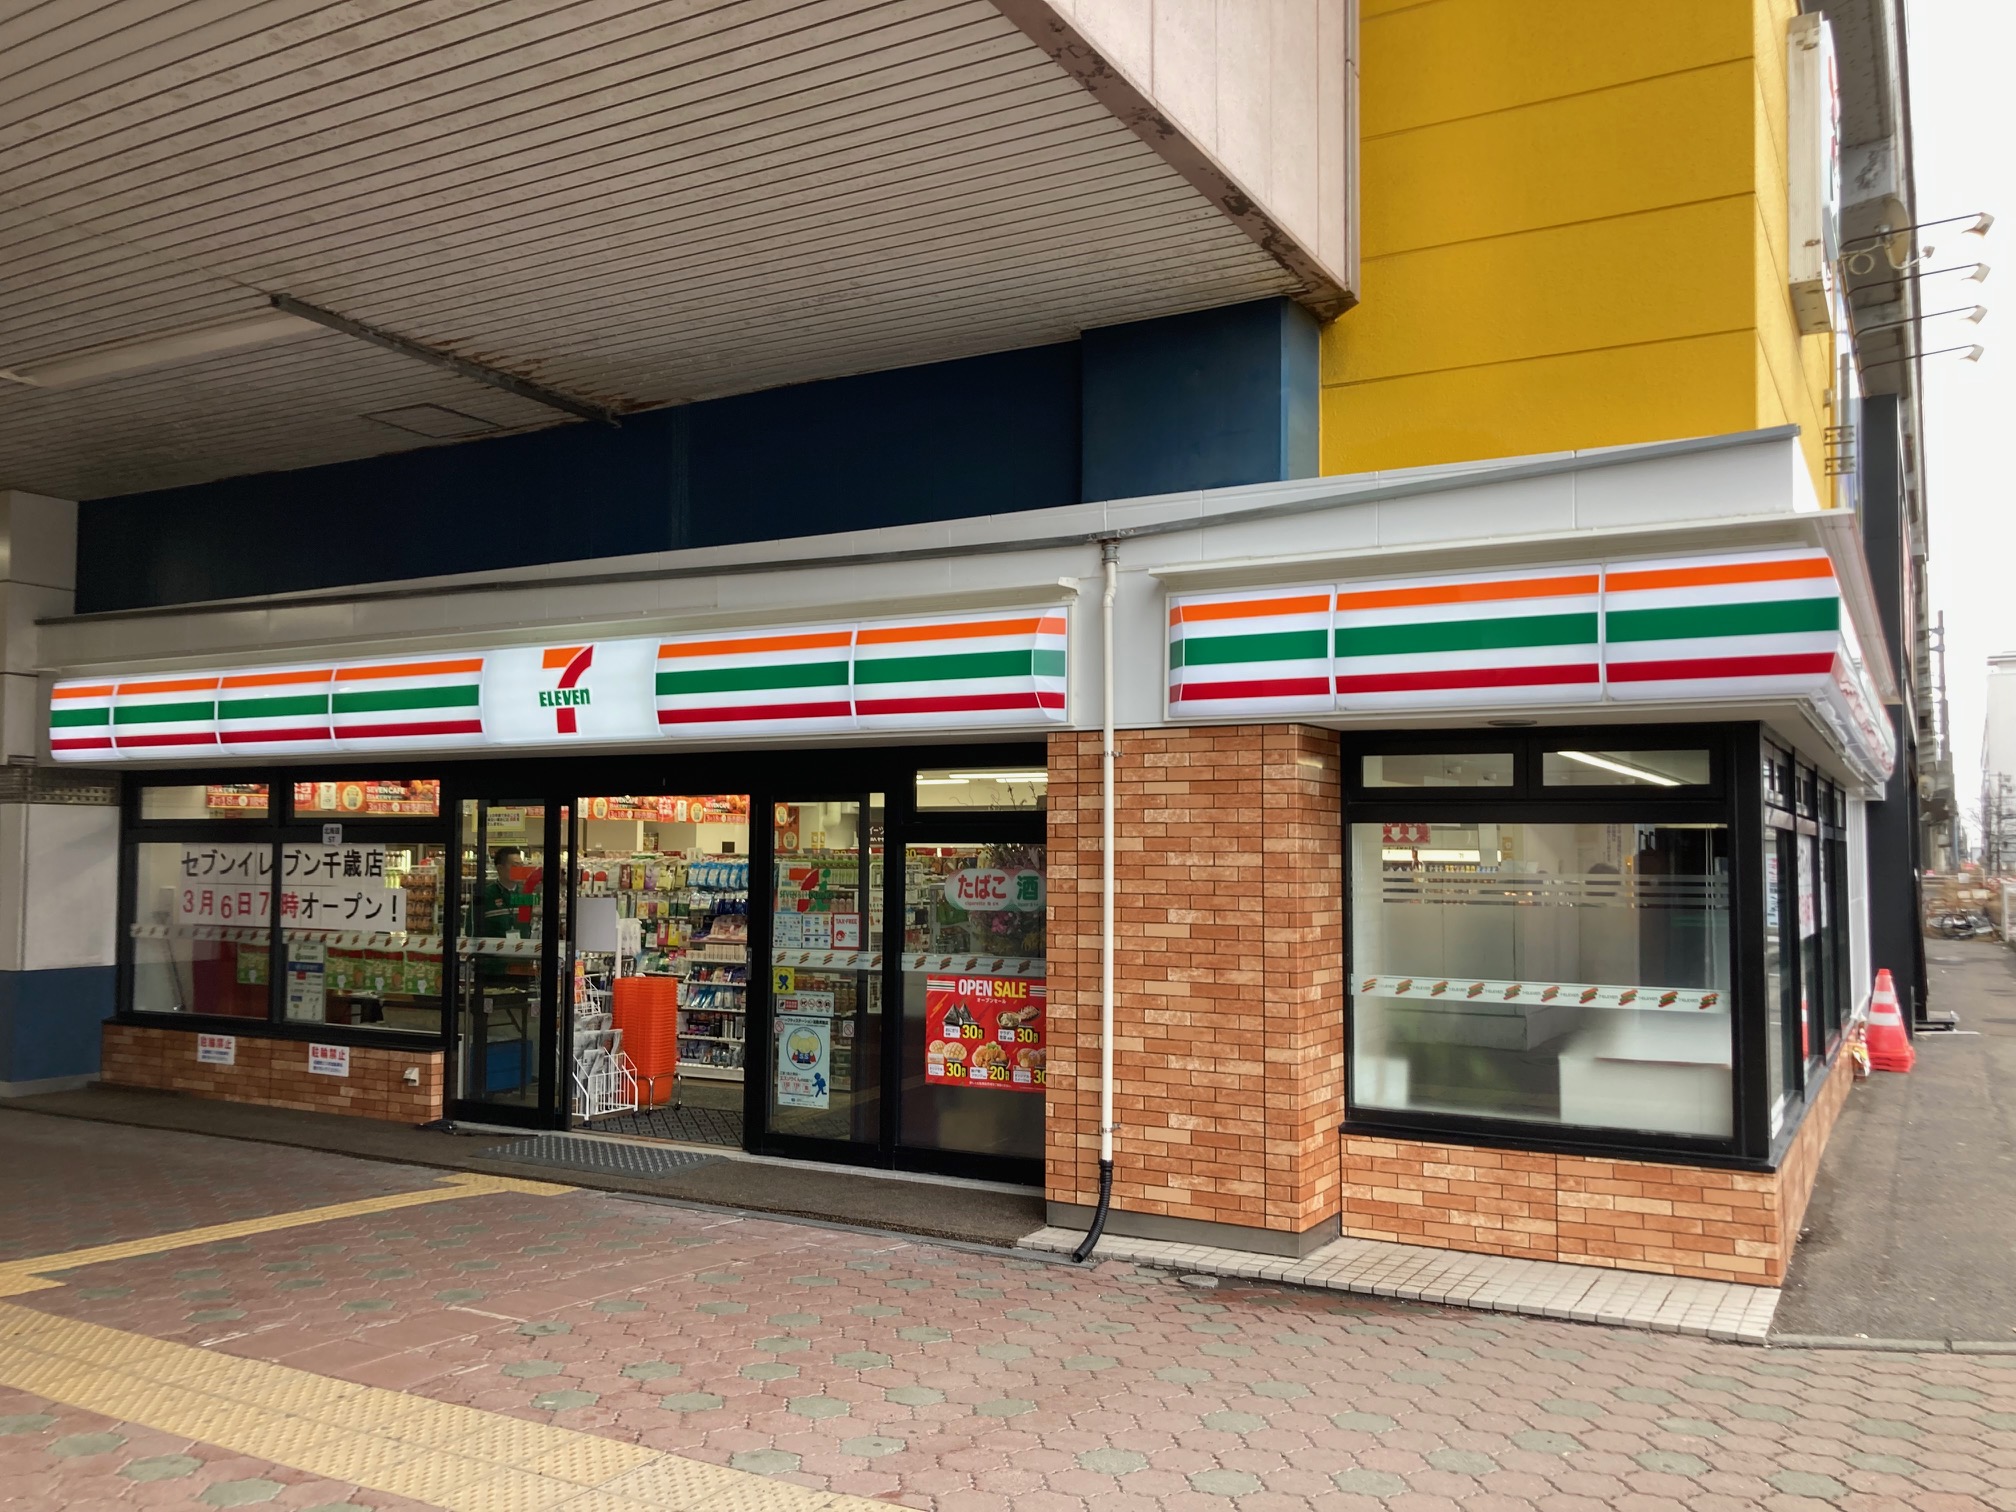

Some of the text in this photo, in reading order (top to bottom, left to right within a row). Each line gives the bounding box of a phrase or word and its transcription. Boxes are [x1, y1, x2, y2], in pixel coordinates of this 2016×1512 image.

[542, 645, 594, 734] 7
[181, 849, 384, 878] セブンイレブン千歳店
[957, 873, 1007, 899] たばこ
[1016, 875, 1039, 900] 酒
[958, 979, 1027, 998] OPEN SALE
